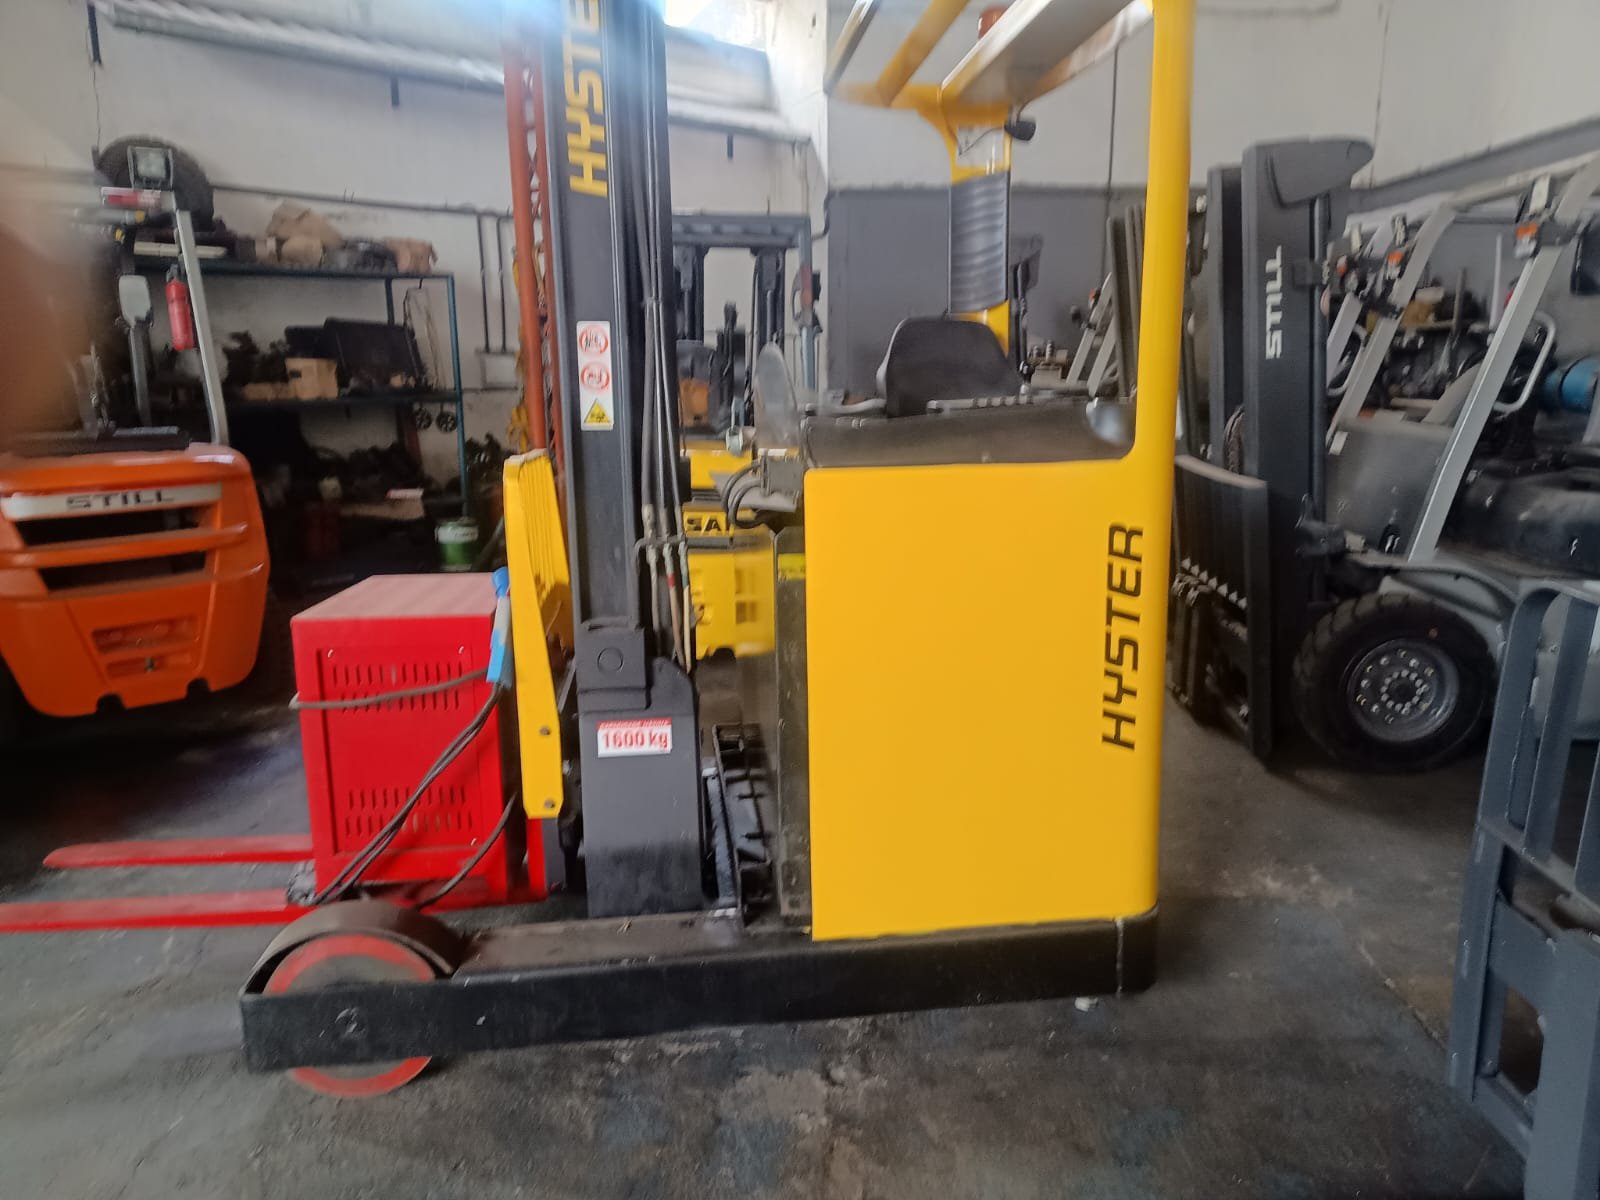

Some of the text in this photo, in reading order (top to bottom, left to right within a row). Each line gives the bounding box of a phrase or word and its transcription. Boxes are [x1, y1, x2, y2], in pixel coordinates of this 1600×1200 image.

[1265, 245, 1282, 360] STILL
[66, 489, 175, 510] STILL
[1101, 521, 1143, 751] HYSTER
[603, 729, 668, 750] 1600 kg
